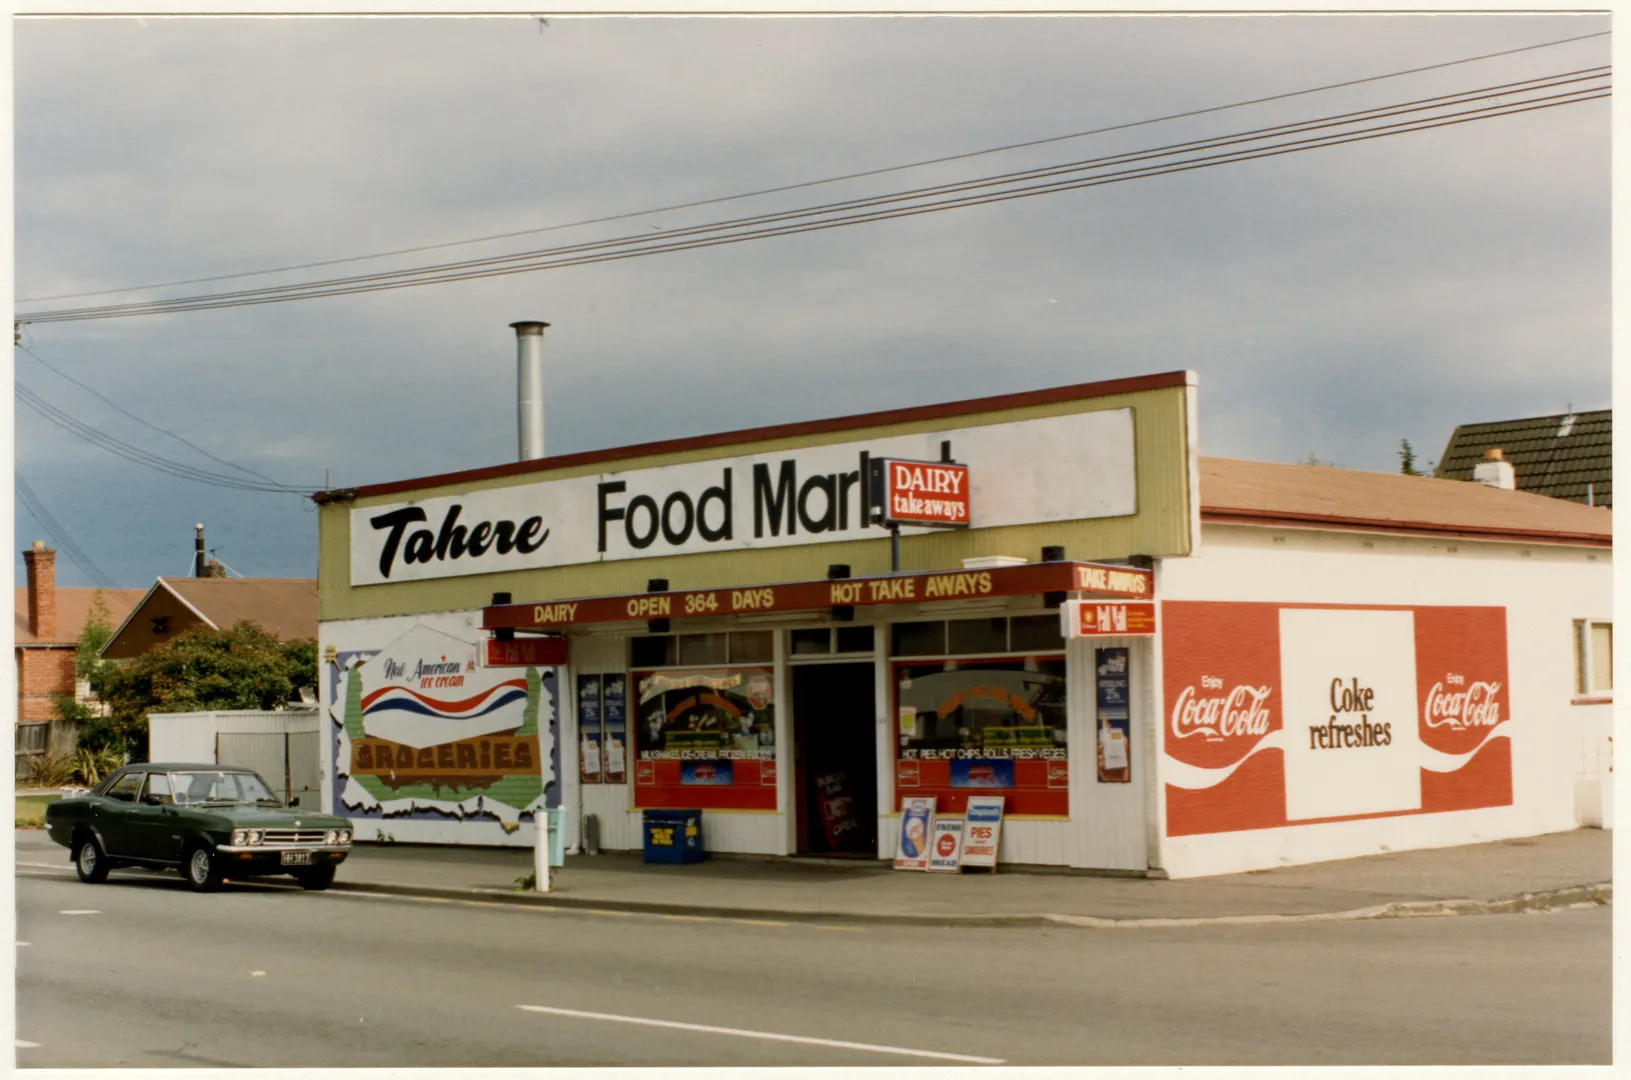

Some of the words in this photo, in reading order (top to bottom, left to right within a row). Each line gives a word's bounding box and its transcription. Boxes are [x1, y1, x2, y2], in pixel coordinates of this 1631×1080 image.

[895, 465, 964, 494] DAIRY
[370, 503, 549, 578] Tahere
[597, 467, 732, 552] Food
[1078, 567, 1106, 589] TAKE
[1108, 571, 1145, 593] AWAYS
[533, 603, 578, 624] DAIRY
[627, 596, 670, 616] OPEN
[685, 593, 718, 613] 364
[732, 588, 774, 609] DAYS
[831, 582, 862, 603] HOT
[868, 578, 915, 600] TAKE
[925, 572, 992, 597] AWAYS
[407, 659, 461, 682] American
[435, 675, 465, 688] cream
[1201, 675, 1224, 690] Enjoy
[1446, 672, 1465, 685] Enjoy
[1329, 677, 1374, 713] Coke
[1424, 681, 1502, 728] Coca-Cola
[1172, 685, 1272, 738] Coca-Cola
[1309, 714, 1392, 750] refreshes
[356, 740, 532, 770] GROCERIES
[902, 749, 918, 759] HOT
[939, 749, 957, 759] HOT
[970, 826, 993, 839] PIES
